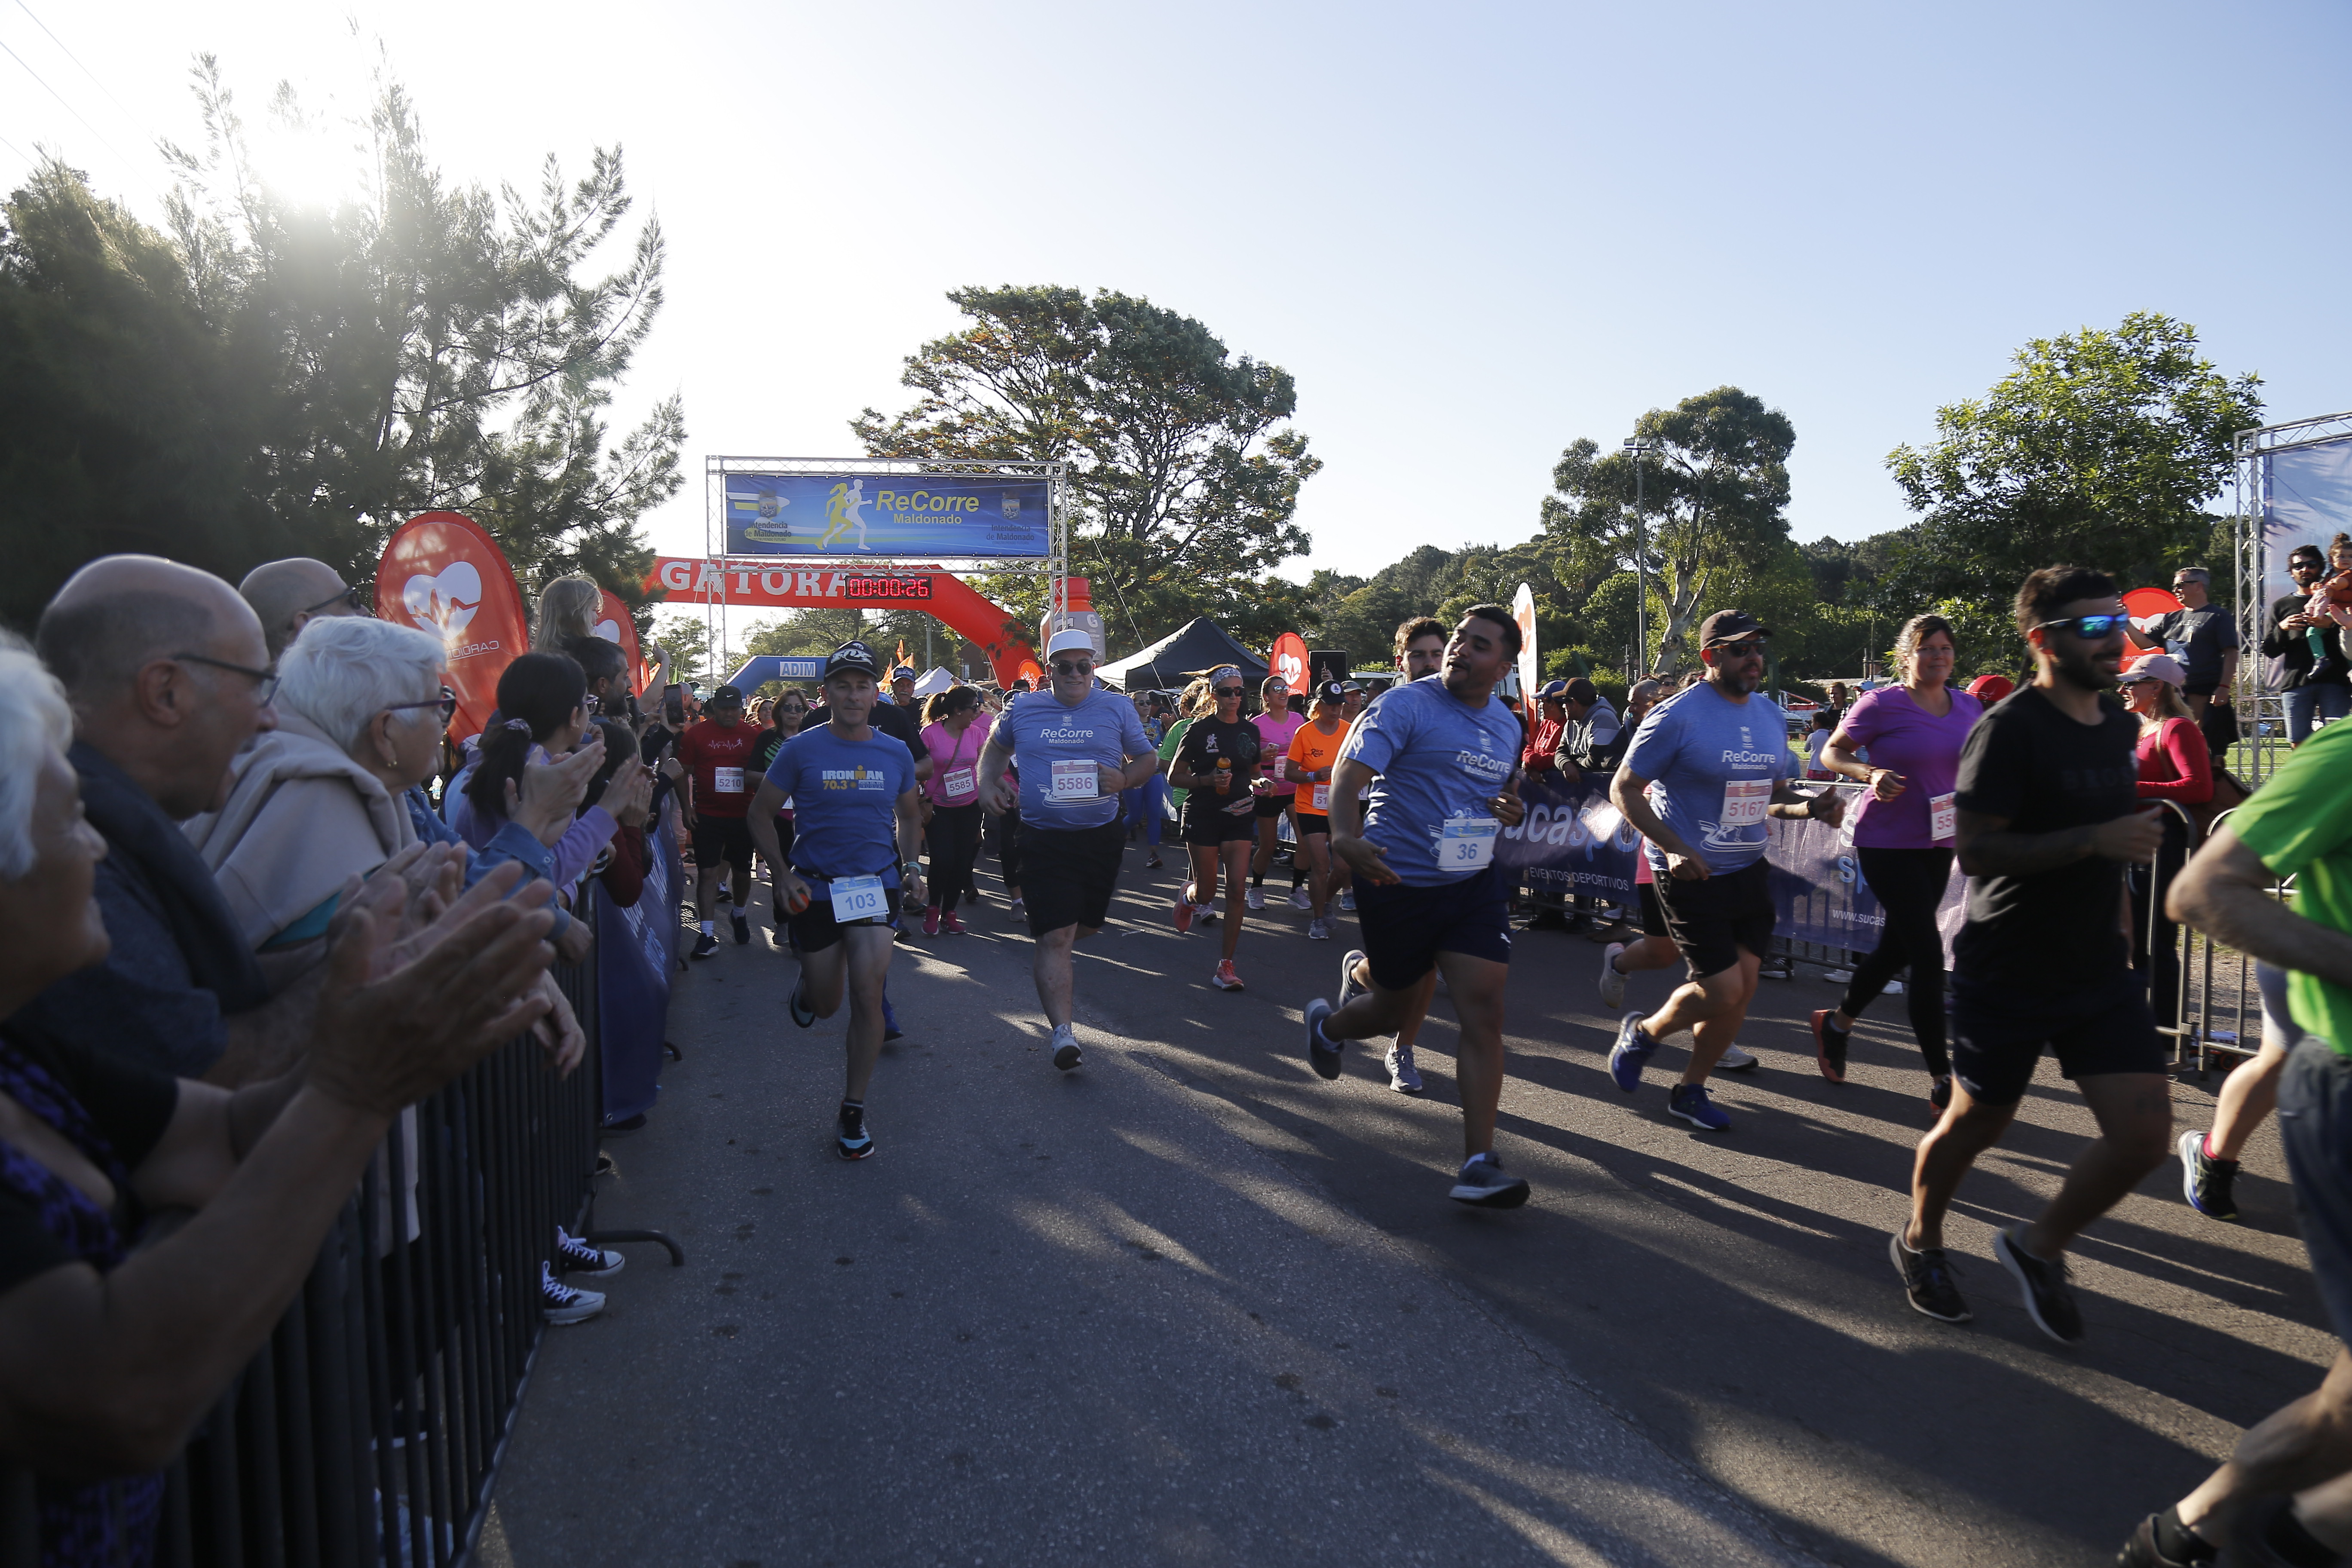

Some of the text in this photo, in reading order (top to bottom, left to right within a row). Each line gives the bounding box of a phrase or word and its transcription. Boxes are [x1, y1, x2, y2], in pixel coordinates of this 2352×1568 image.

[876, 490, 979, 512] ReCorre
[894, 514, 962, 524] Maldonado
[661, 561, 915, 597] GATORA
[849, 578, 930, 597] 00:00:26
[782, 663, 815, 677] ADIM
[1040, 729, 1093, 738] ReCorre
[1456, 750, 1510, 774] ReCorre
[1722, 750, 1776, 763] ReCorre
[822, 765, 884, 780] IRONMAN
[719, 779, 741, 787] 5210
[823, 780, 848, 790] 70.3
[949, 780, 971, 792] 5585
[1058, 777, 1093, 791] 5586
[1317, 796, 1327, 805] 51
[1729, 801, 1765, 817] 5167
[1457, 843, 1478, 860] 36
[1530, 867, 1629, 891] EVENTOS DEPORTIVOS
[845, 893, 876, 911] 103
[1833, 909, 1885, 927] www.sucas
